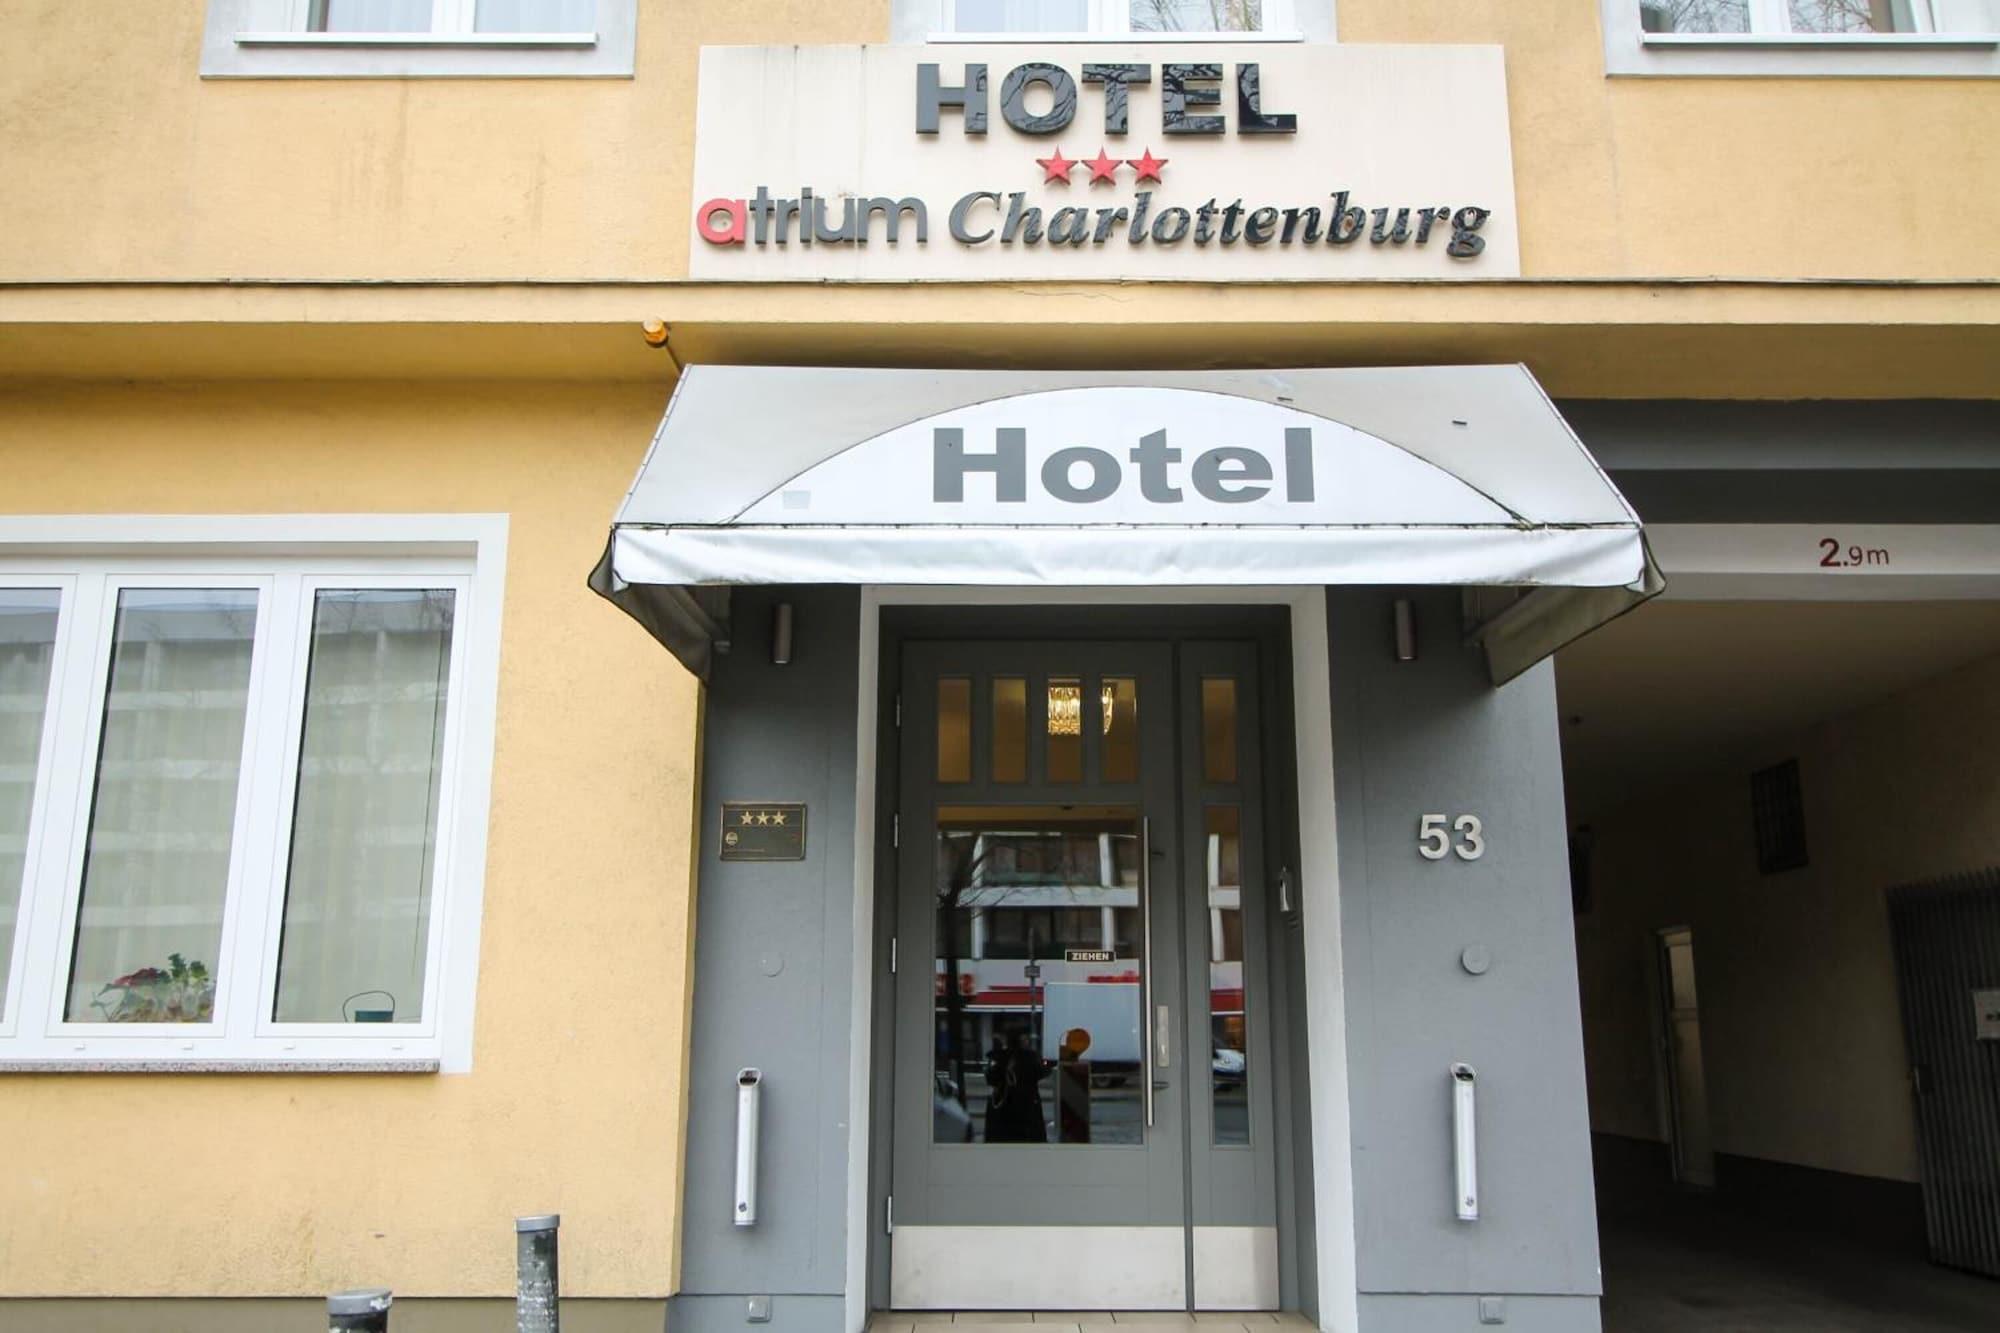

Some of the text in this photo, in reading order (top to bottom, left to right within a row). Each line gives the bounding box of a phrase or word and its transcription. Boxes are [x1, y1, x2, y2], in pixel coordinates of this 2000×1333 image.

[917, 63, 1297, 136] HOTEL
[697, 186, 1491, 258] atrium Charlottenburg
[932, 427, 1315, 504] Hotel
[1418, 814, 1486, 861] 53
[1071, 952, 1110, 961] ZIEHEN
